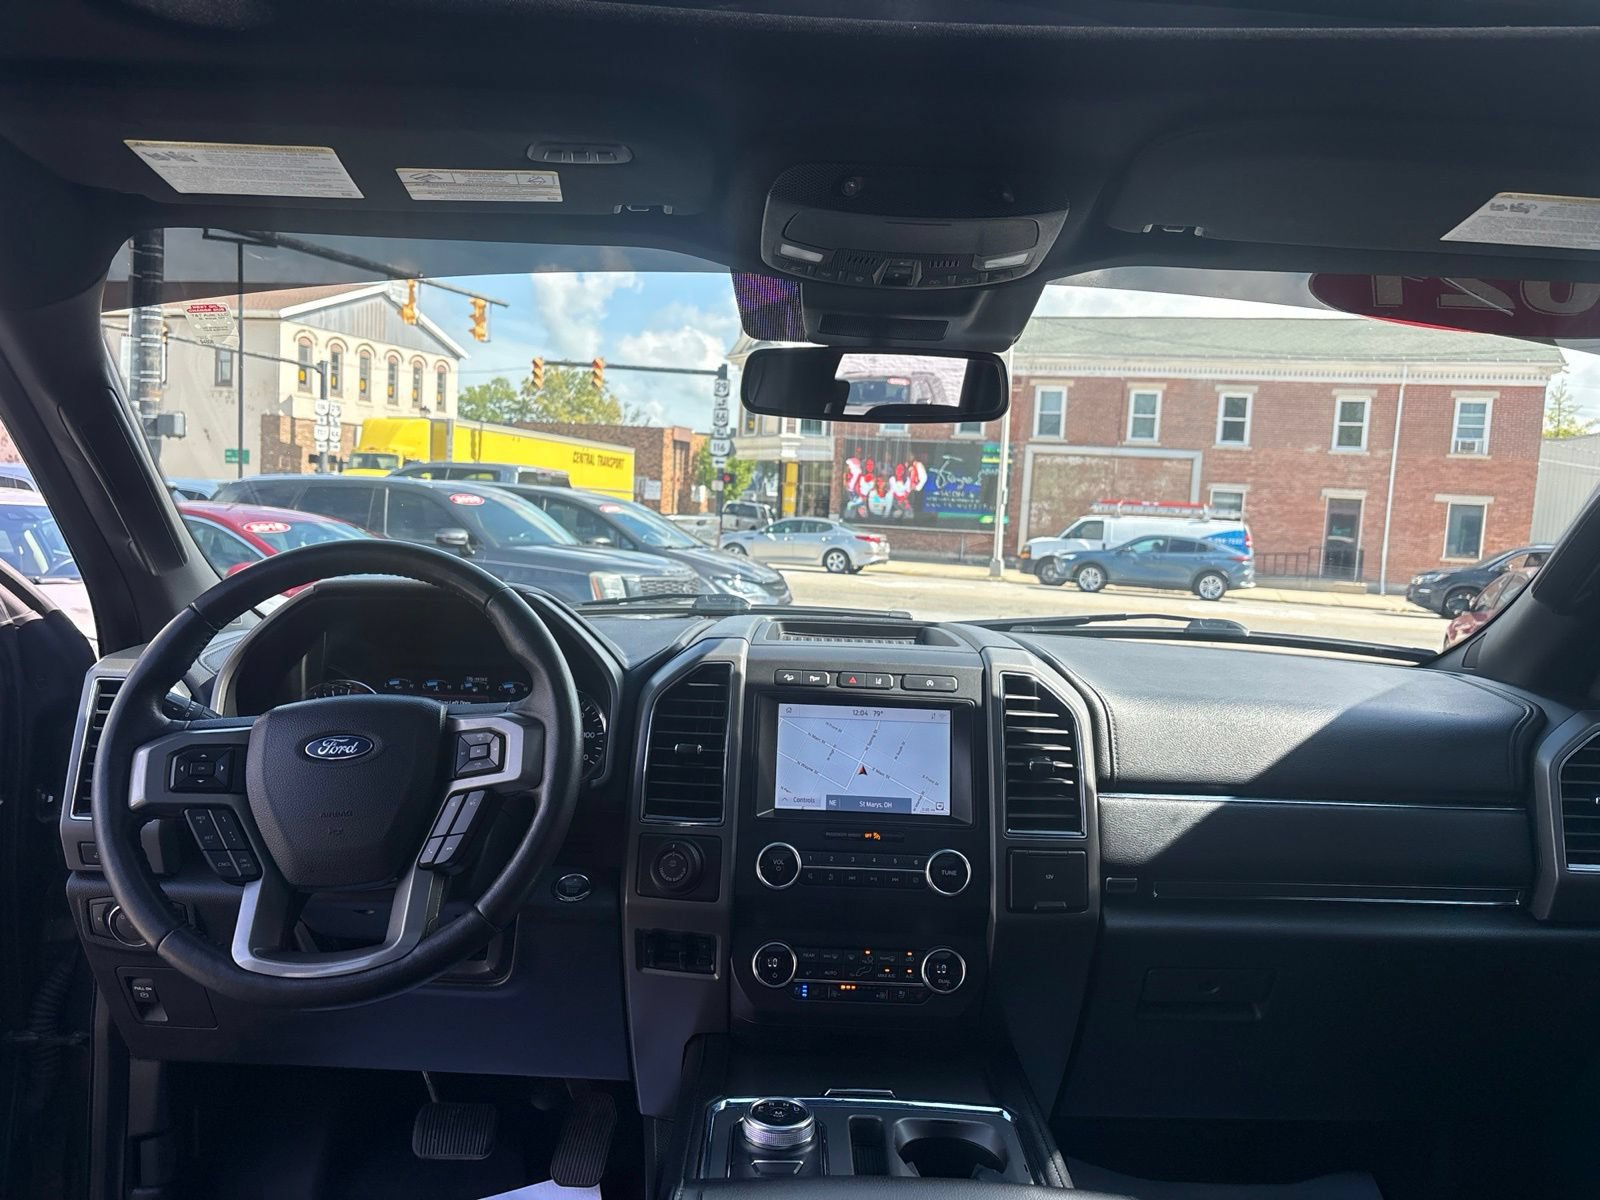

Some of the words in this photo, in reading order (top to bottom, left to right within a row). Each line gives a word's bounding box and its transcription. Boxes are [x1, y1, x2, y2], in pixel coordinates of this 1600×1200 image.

[713, 443, 726, 452] 116
[573, 451, 595, 466] CENTRAL
[597, 454, 625, 469] TRANSPORT
[318, 738, 359, 755] Ford
